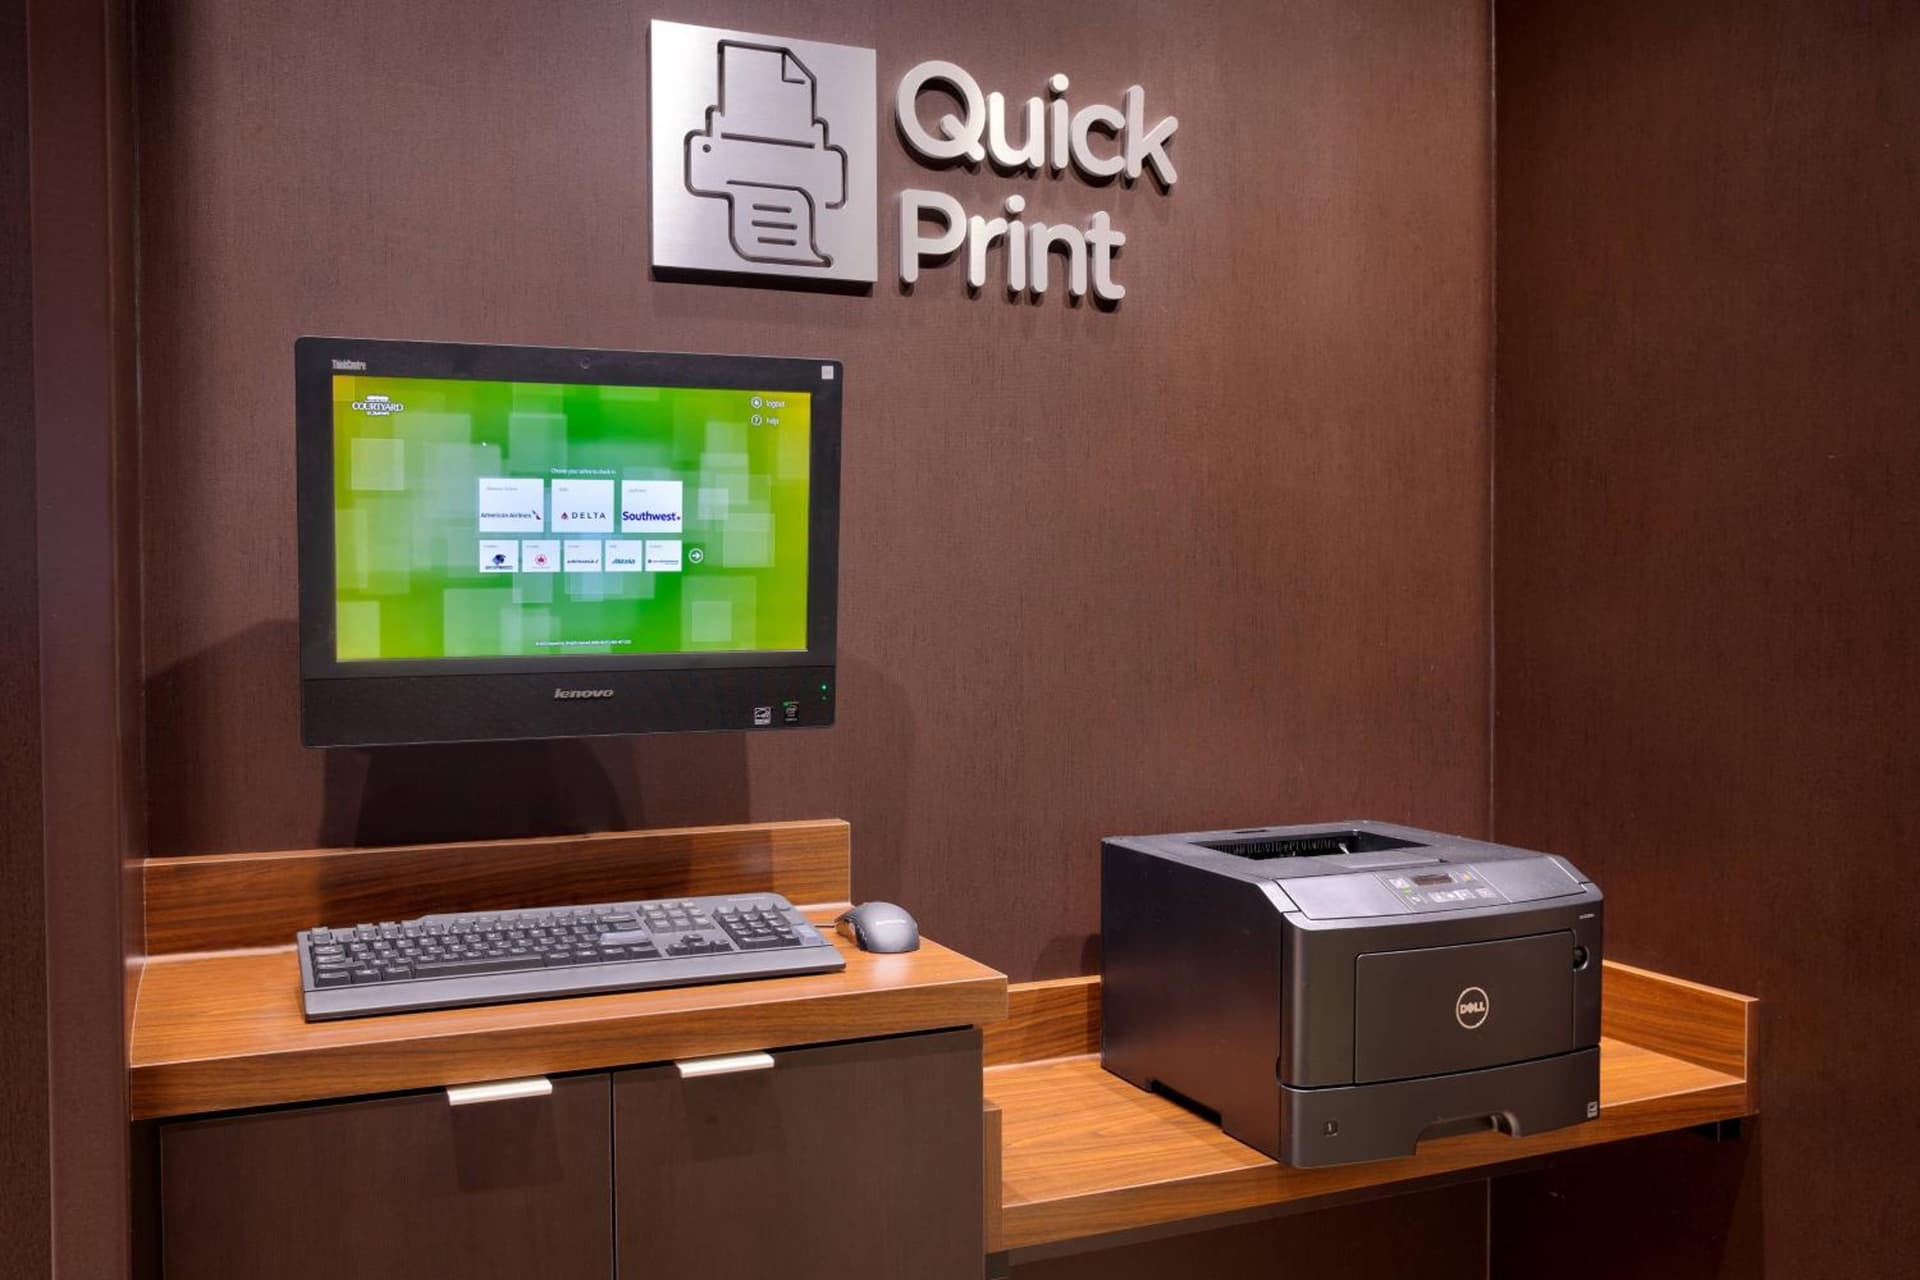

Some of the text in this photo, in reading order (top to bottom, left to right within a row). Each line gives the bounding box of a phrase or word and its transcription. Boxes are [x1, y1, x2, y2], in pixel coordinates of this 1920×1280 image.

[895, 60, 1179, 186] Quick
[898, 187, 1127, 302] Print
[352, 401, 404, 412] COURTYARD
[571, 511, 606, 520] DELTA
[622, 511, 676, 521] Southwest
[553, 688, 614, 699] lenovo
[1459, 1001, 1486, 1015] DELL
